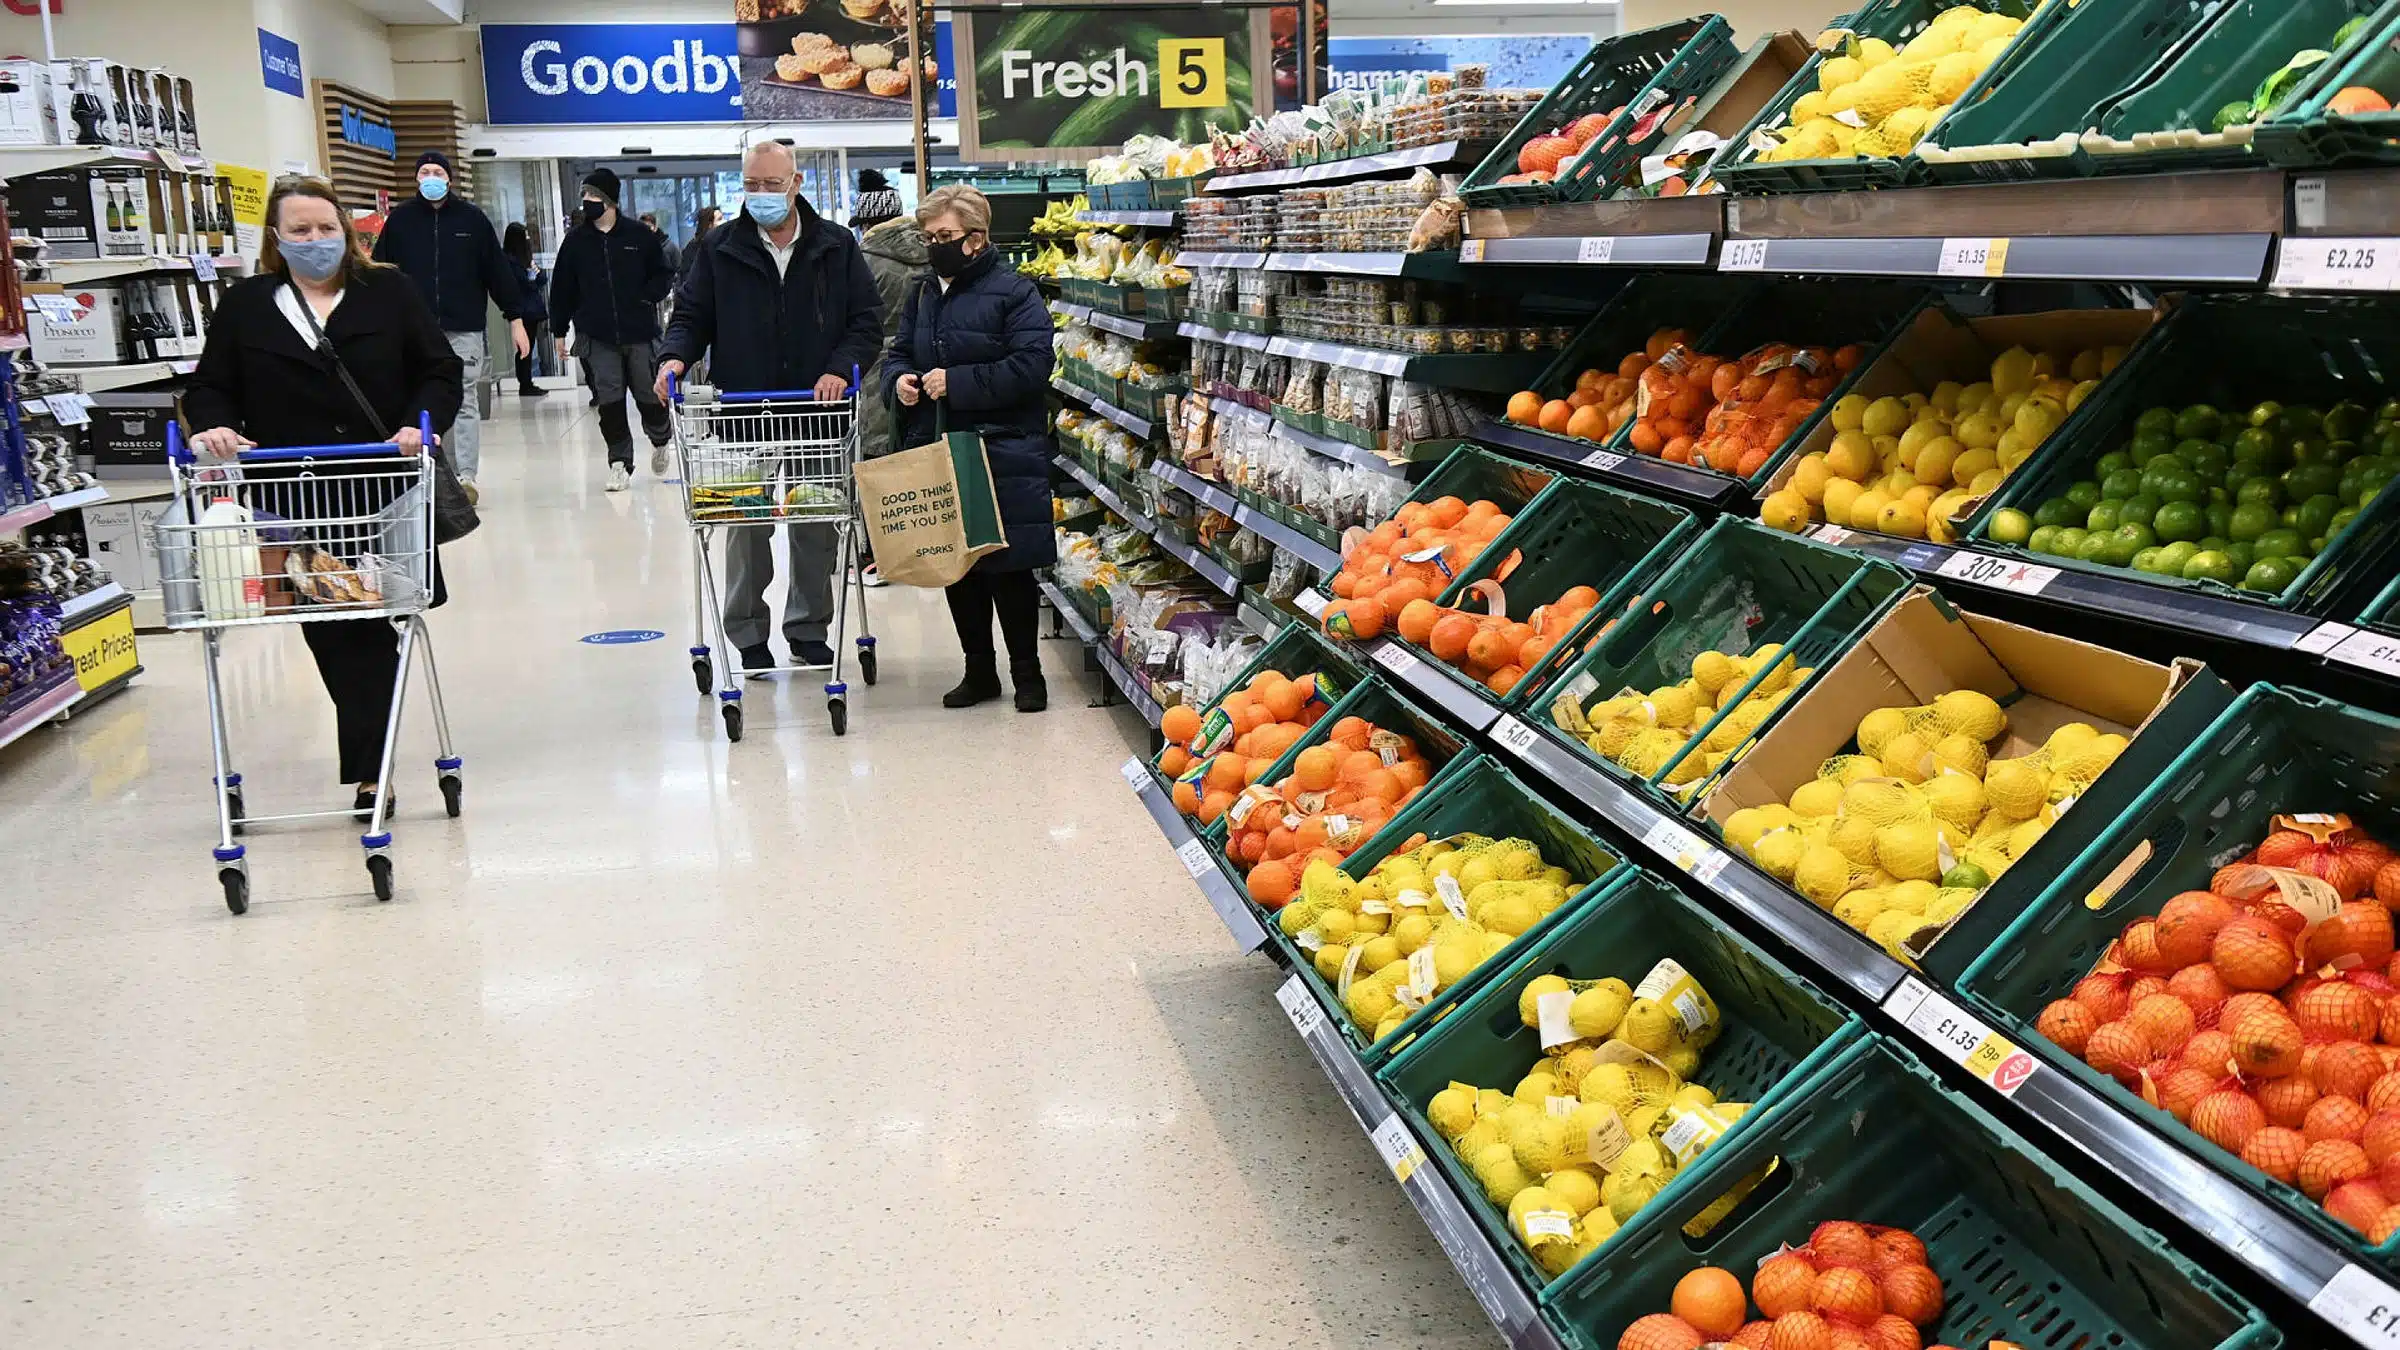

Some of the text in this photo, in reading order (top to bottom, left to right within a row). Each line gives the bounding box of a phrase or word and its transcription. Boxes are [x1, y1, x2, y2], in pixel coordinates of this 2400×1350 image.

[1002, 47, 1207, 99] Fresh 5
[1327, 64, 1441, 90] harmac
[1732, 242, 1764, 266] £1.75
[1957, 249, 1986, 264] £1.35
[2326, 248, 2376, 269] £2.25
[109, 440, 162, 448] PROSECCO
[881, 490, 917, 506] GOOD
[881, 504, 928, 521] HAPPEN
[880, 520, 906, 536] TIME
[910, 515, 937, 529] YOU
[915, 543, 954, 558] SPARKS
[1958, 556, 2007, 582] 30p
[75, 632, 133, 673] reat Prices
[2368, 645, 2400, 664] £1.
[1936, 1018, 2000, 1062] £1.35 79p
